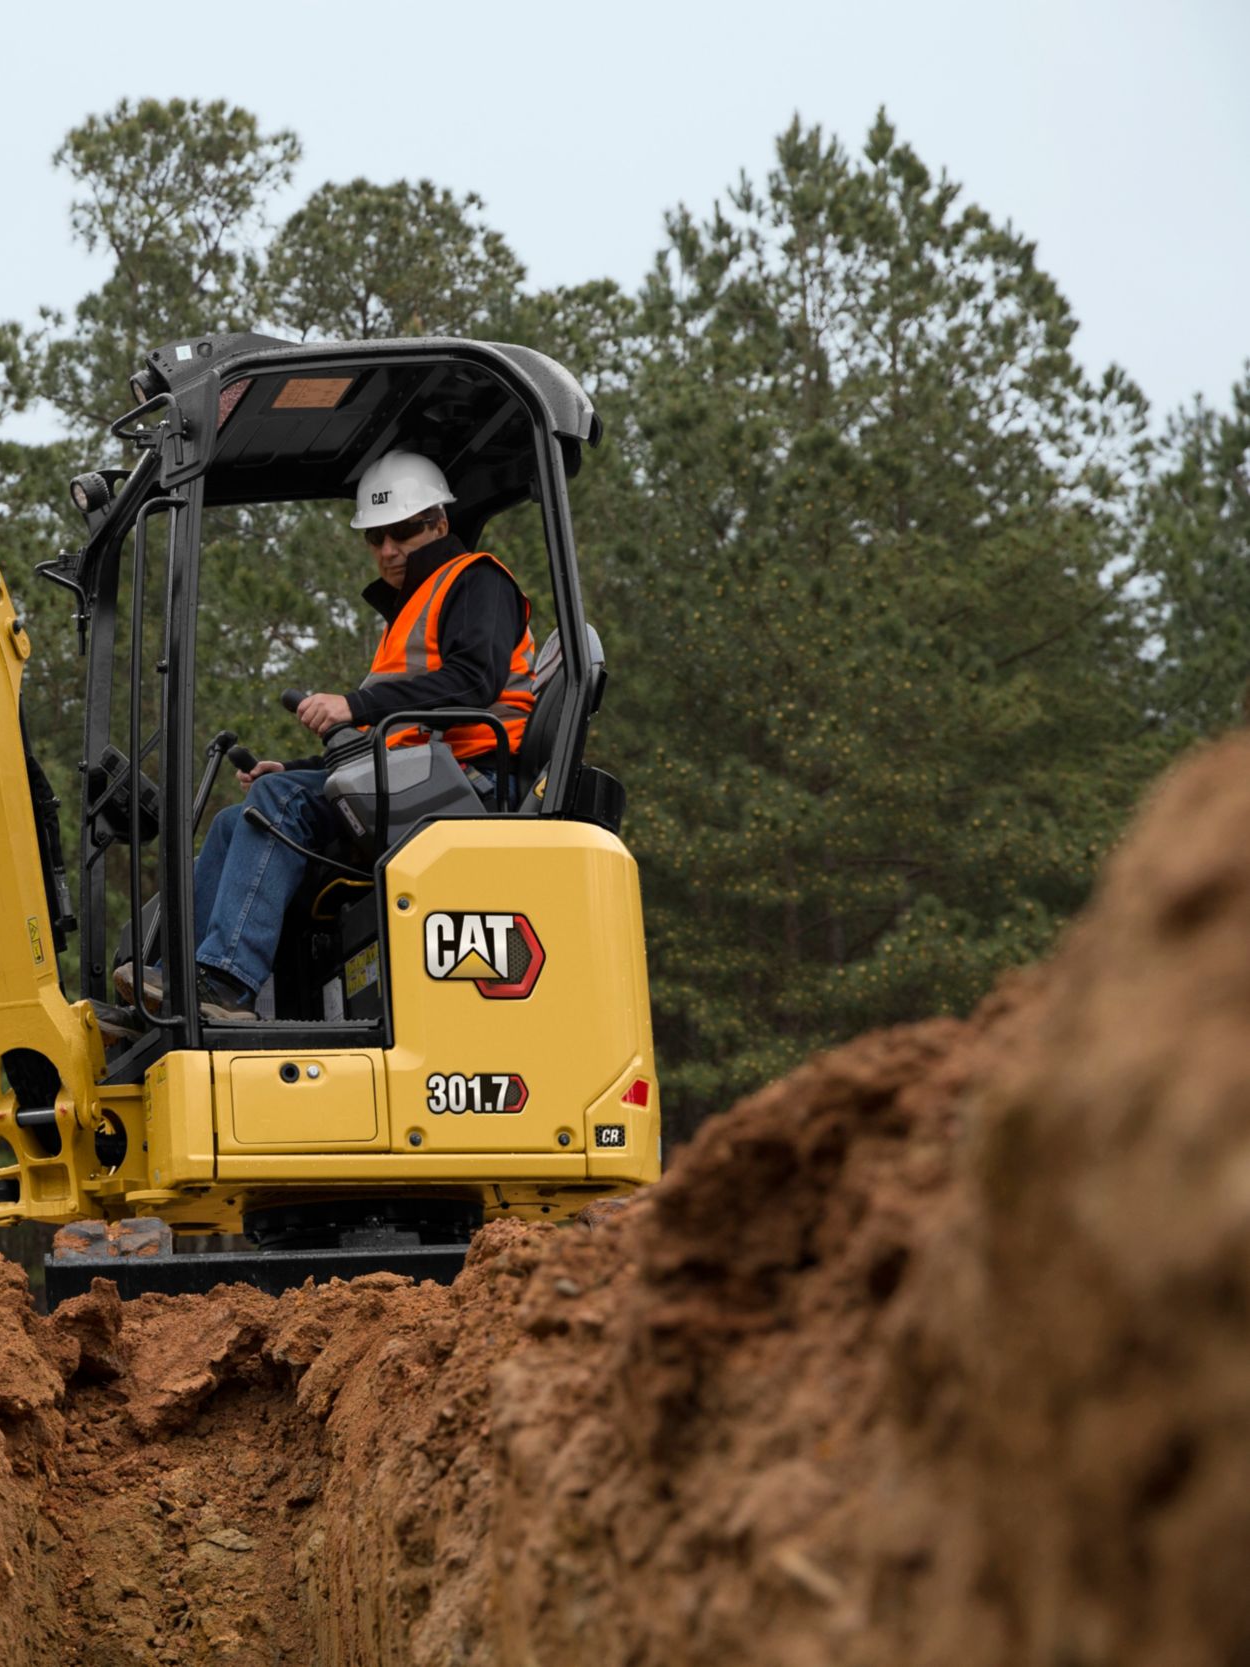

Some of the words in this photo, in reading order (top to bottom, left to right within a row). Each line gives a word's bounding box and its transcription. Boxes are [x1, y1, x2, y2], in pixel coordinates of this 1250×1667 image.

[372, 491, 389, 505] CAT
[425, 913, 514, 979] CAT
[428, 1074, 510, 1112] 301.7
[602, 1129, 619, 1143] CR
